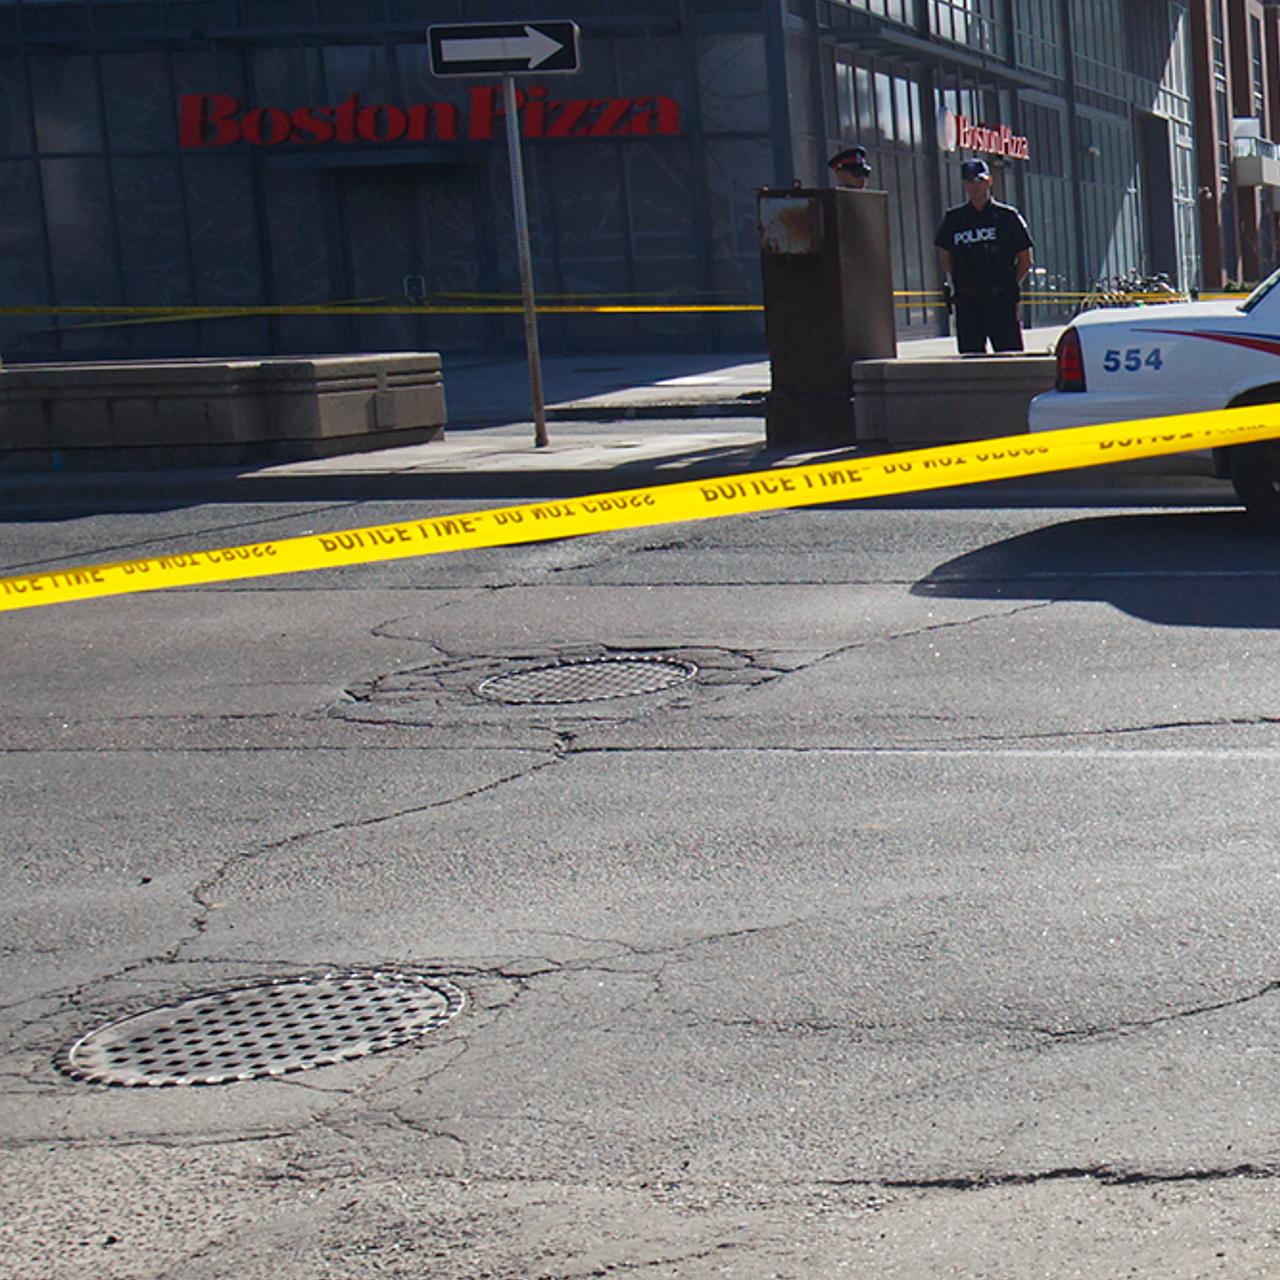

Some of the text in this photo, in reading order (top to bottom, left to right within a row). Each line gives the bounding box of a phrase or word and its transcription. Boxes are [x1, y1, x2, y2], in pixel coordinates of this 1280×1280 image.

[178, 84, 683, 149] Boston Pizza
[954, 227, 997, 245] POLICE
[1103, 348, 1163, 372] 554
